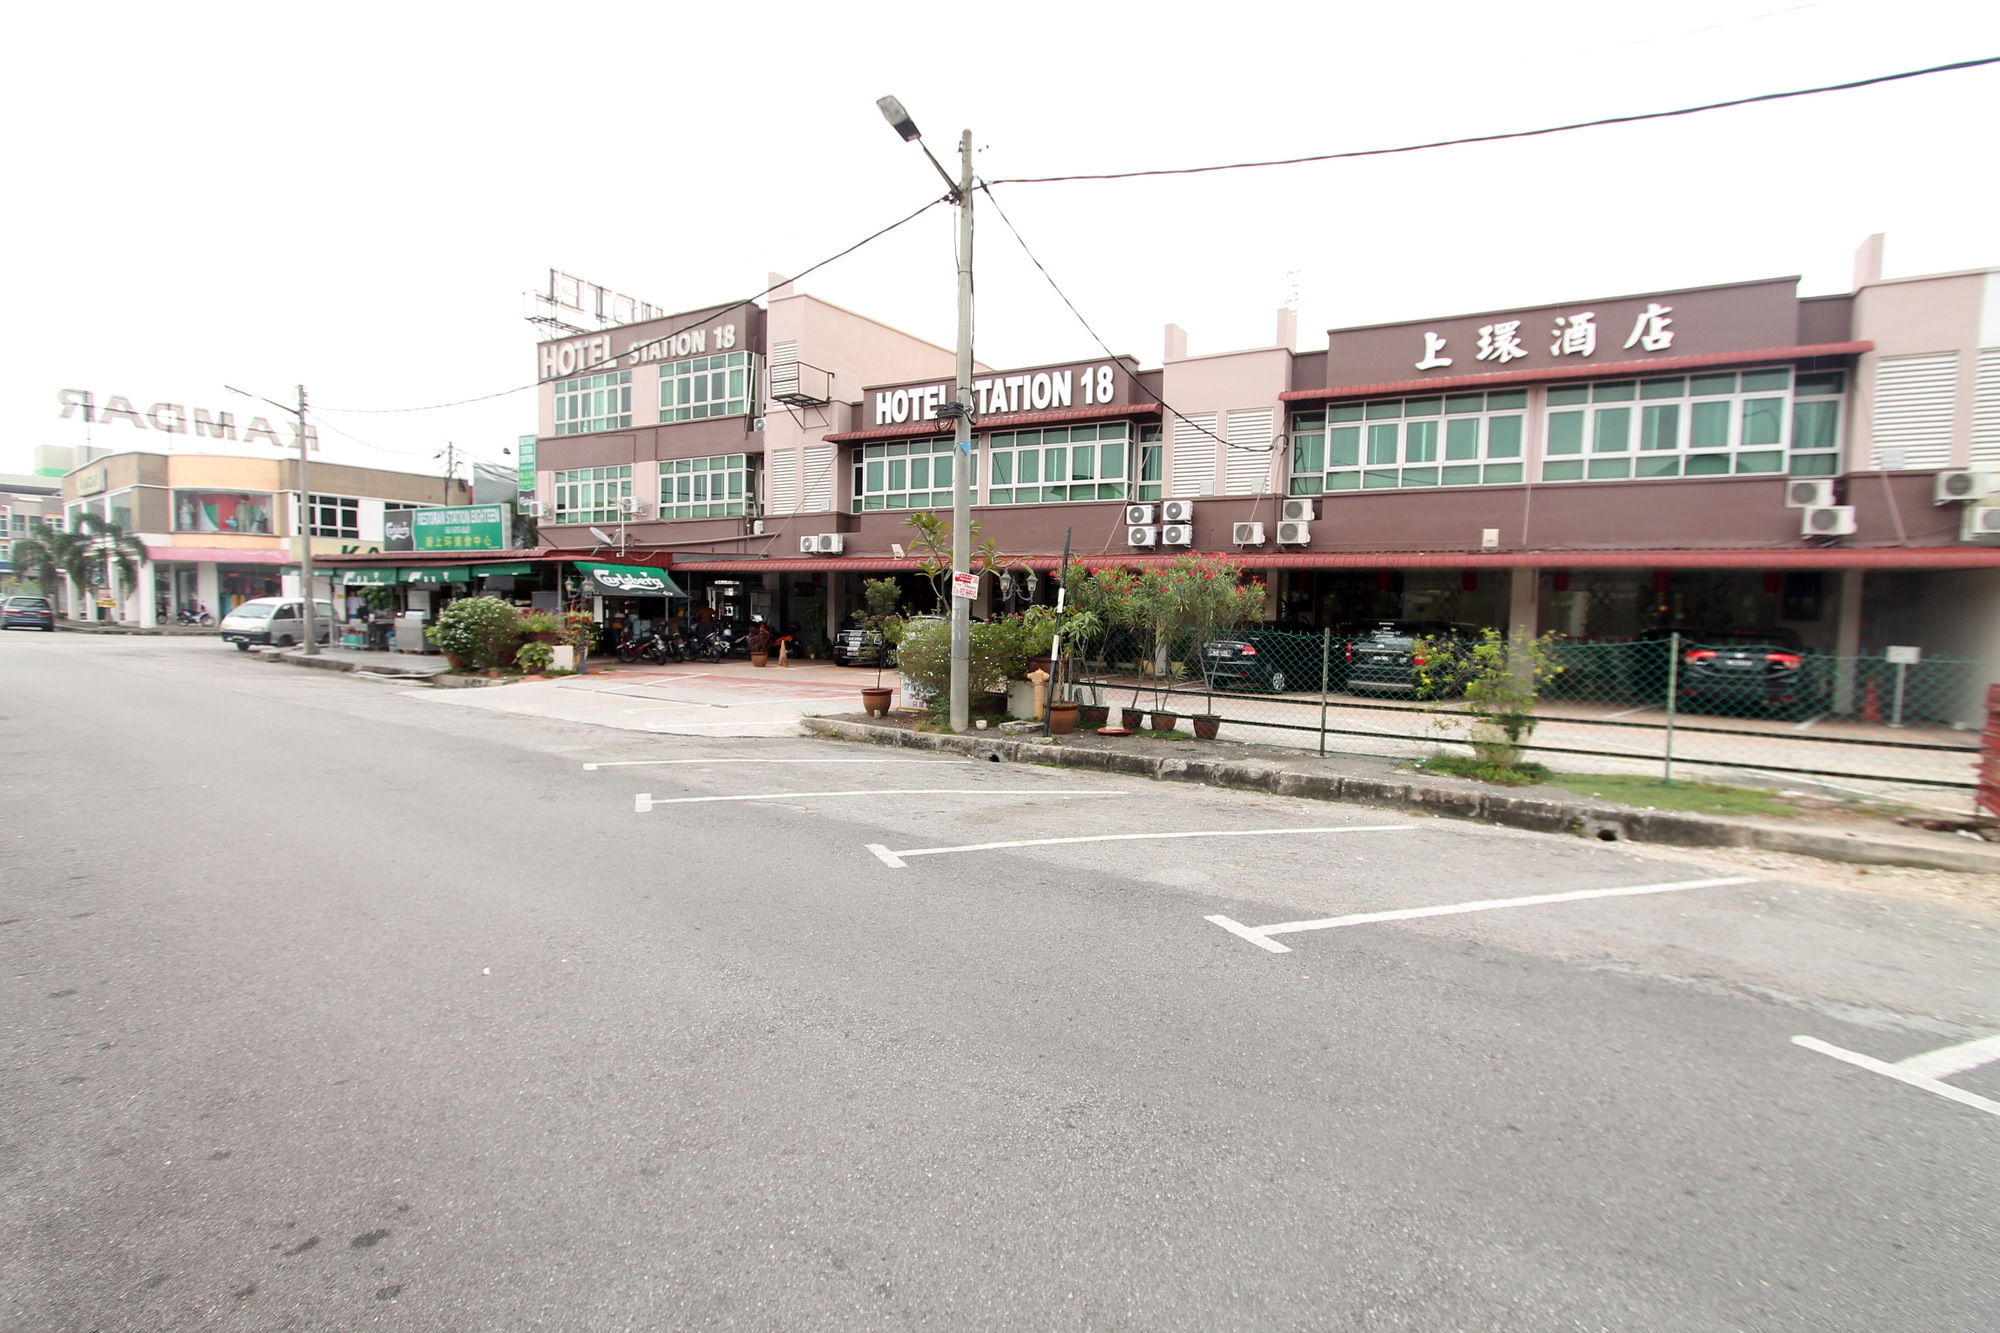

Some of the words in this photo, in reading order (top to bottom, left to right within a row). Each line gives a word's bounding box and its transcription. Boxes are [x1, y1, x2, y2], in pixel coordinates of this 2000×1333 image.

[540, 334, 618, 379] HOTEL
[628, 329, 707, 365] STATION
[713, 323, 737, 350] 18
[1414, 303, 1676, 371] 上環酒店
[1080, 365, 1115, 404] 18
[593, 569, 665, 590] Carlsberg
